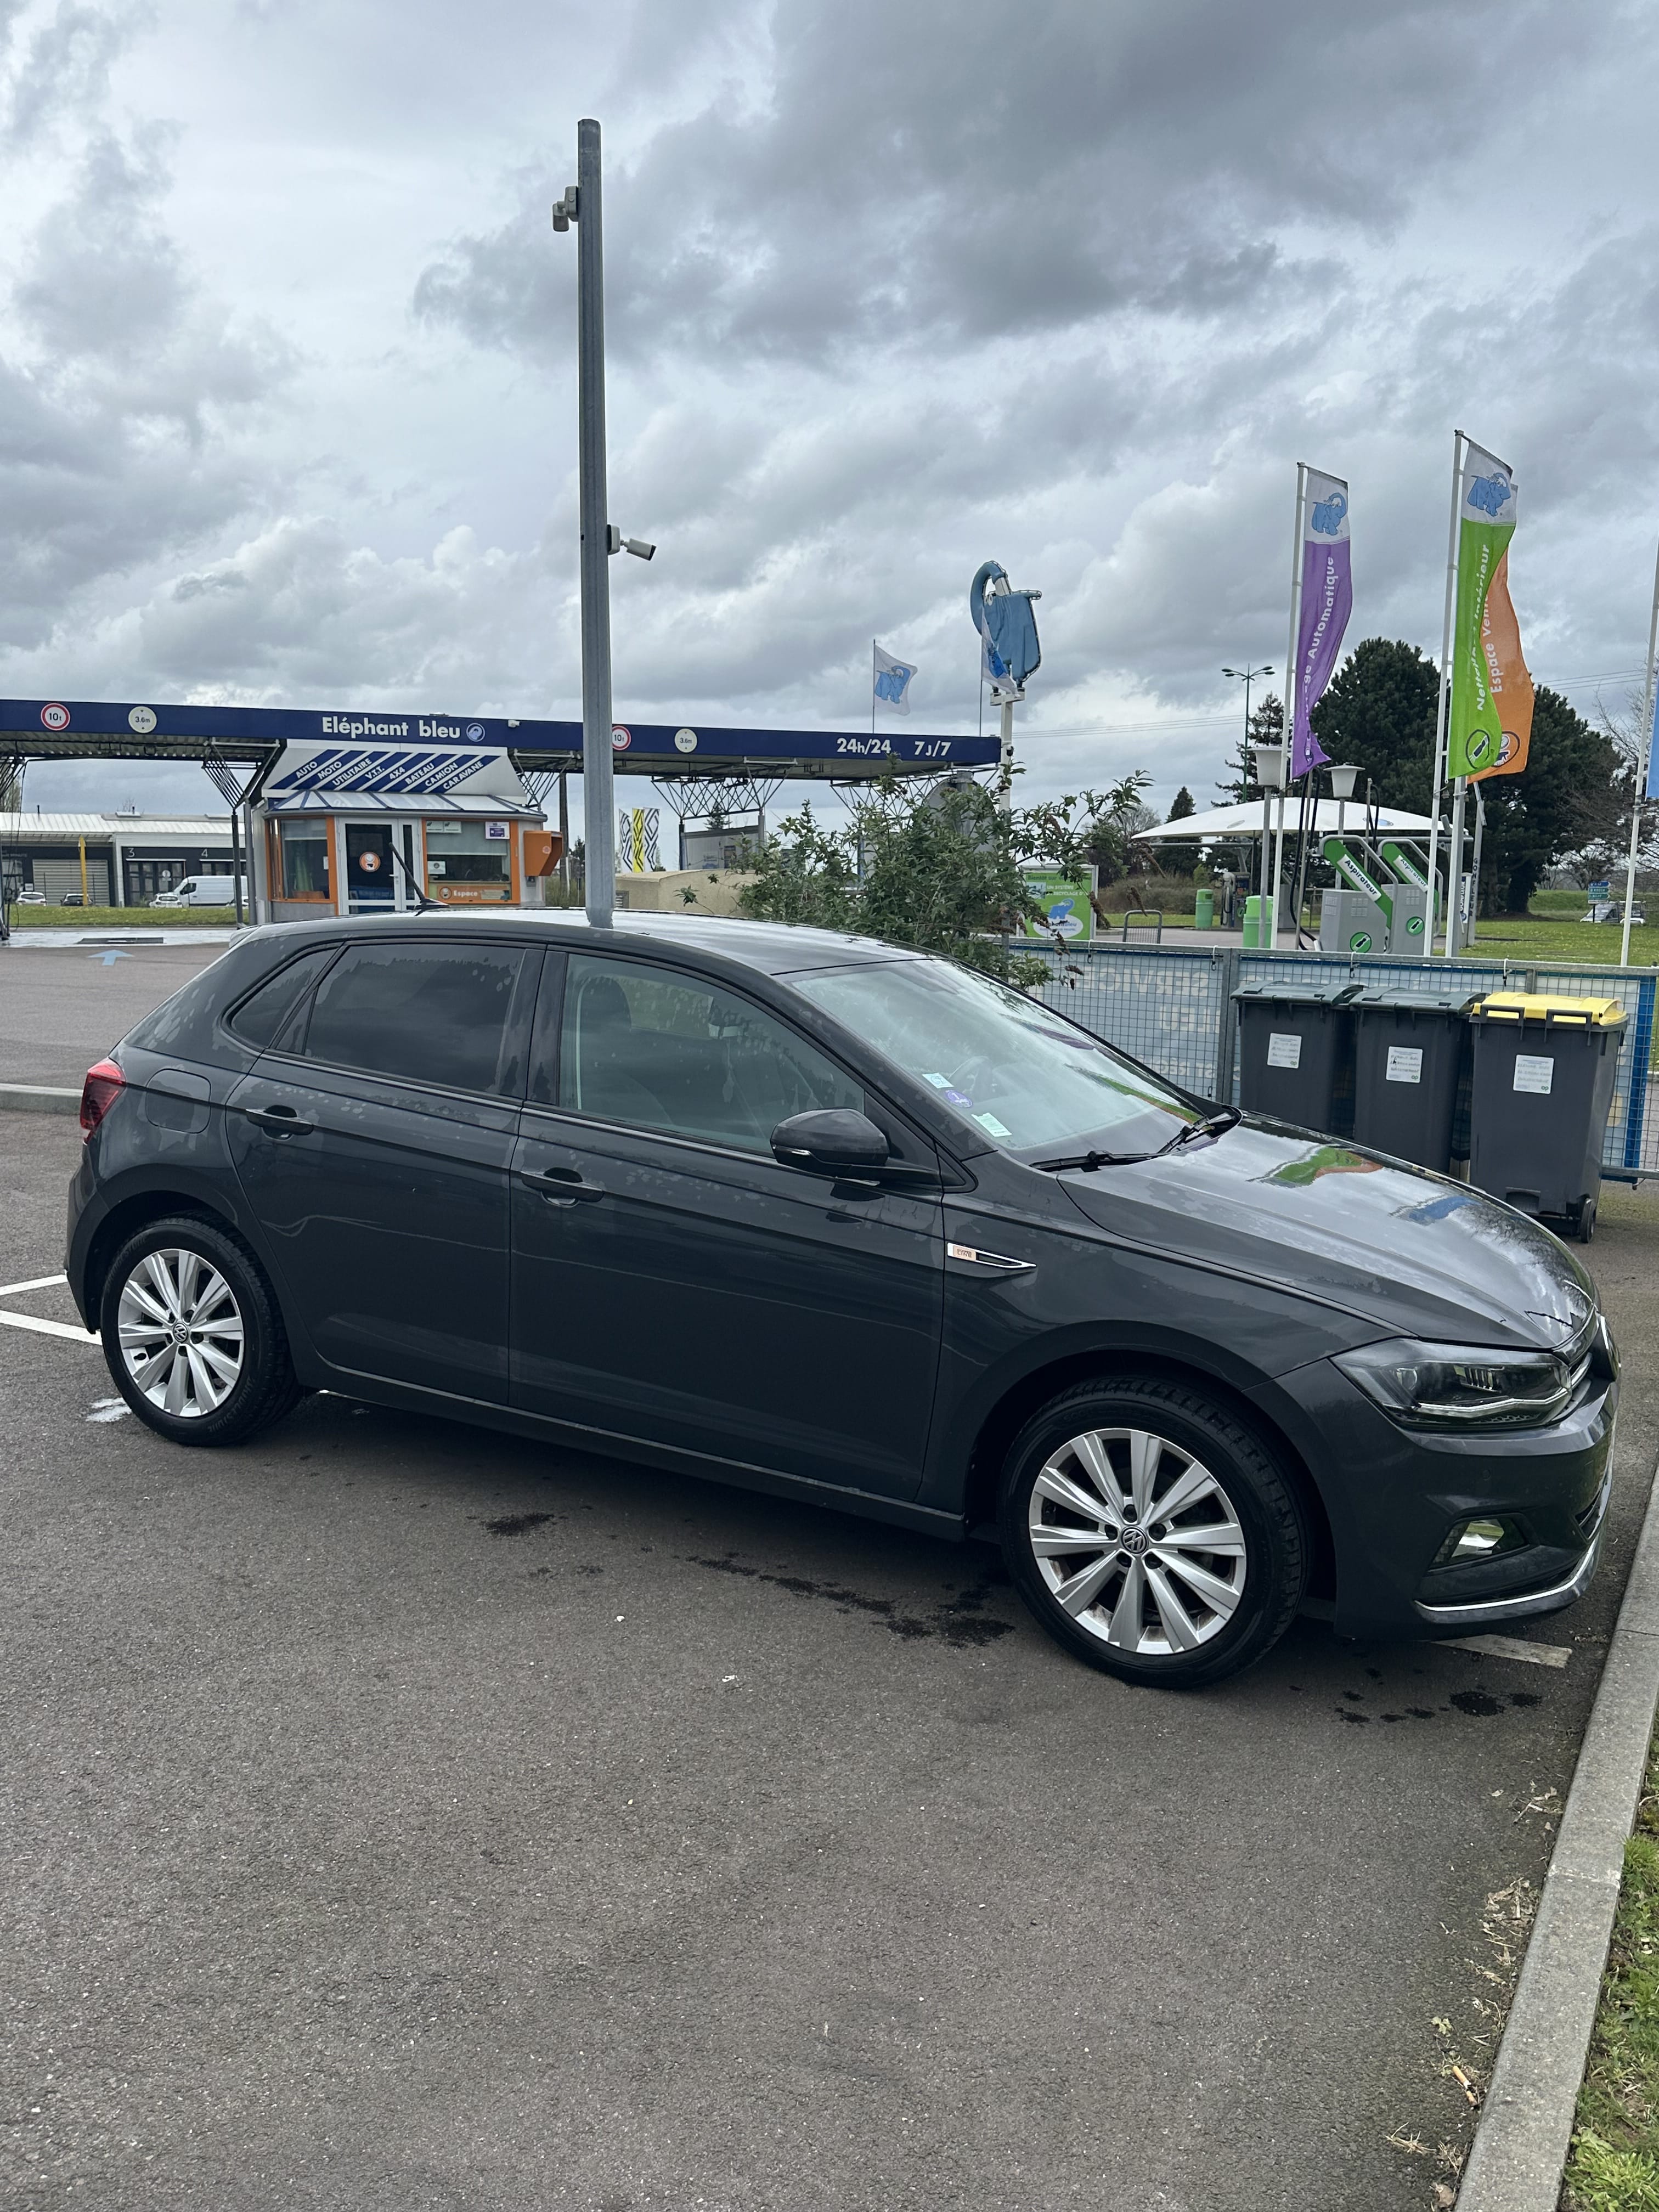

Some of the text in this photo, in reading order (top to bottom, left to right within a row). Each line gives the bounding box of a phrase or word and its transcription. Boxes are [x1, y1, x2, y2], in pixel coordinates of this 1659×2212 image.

[1307, 556, 1339, 659] Automatique
[1485, 642, 1503, 693] Espace
[49, 712, 62, 721] 10t
[134, 715, 151, 724] 3.6m
[322, 716, 460, 738] Eléphant bleu
[837, 737, 891, 755] 24h/24
[295, 760, 318, 780] AUTO
[317, 760, 342, 780] MOTO
[332, 757, 373, 786] UTILITAIRE
[404, 762, 435, 785] BATEAU
[425, 762, 459, 788] CAMION
[443, 760, 484, 790] CARAVANE
[127, 848, 136, 857] 3
[201, 849, 208, 857] 4
[1344, 860, 1378, 895] Aspirateur
[1400, 859, 1426, 887] Aspirateur
[453, 889, 478, 898] Espace
